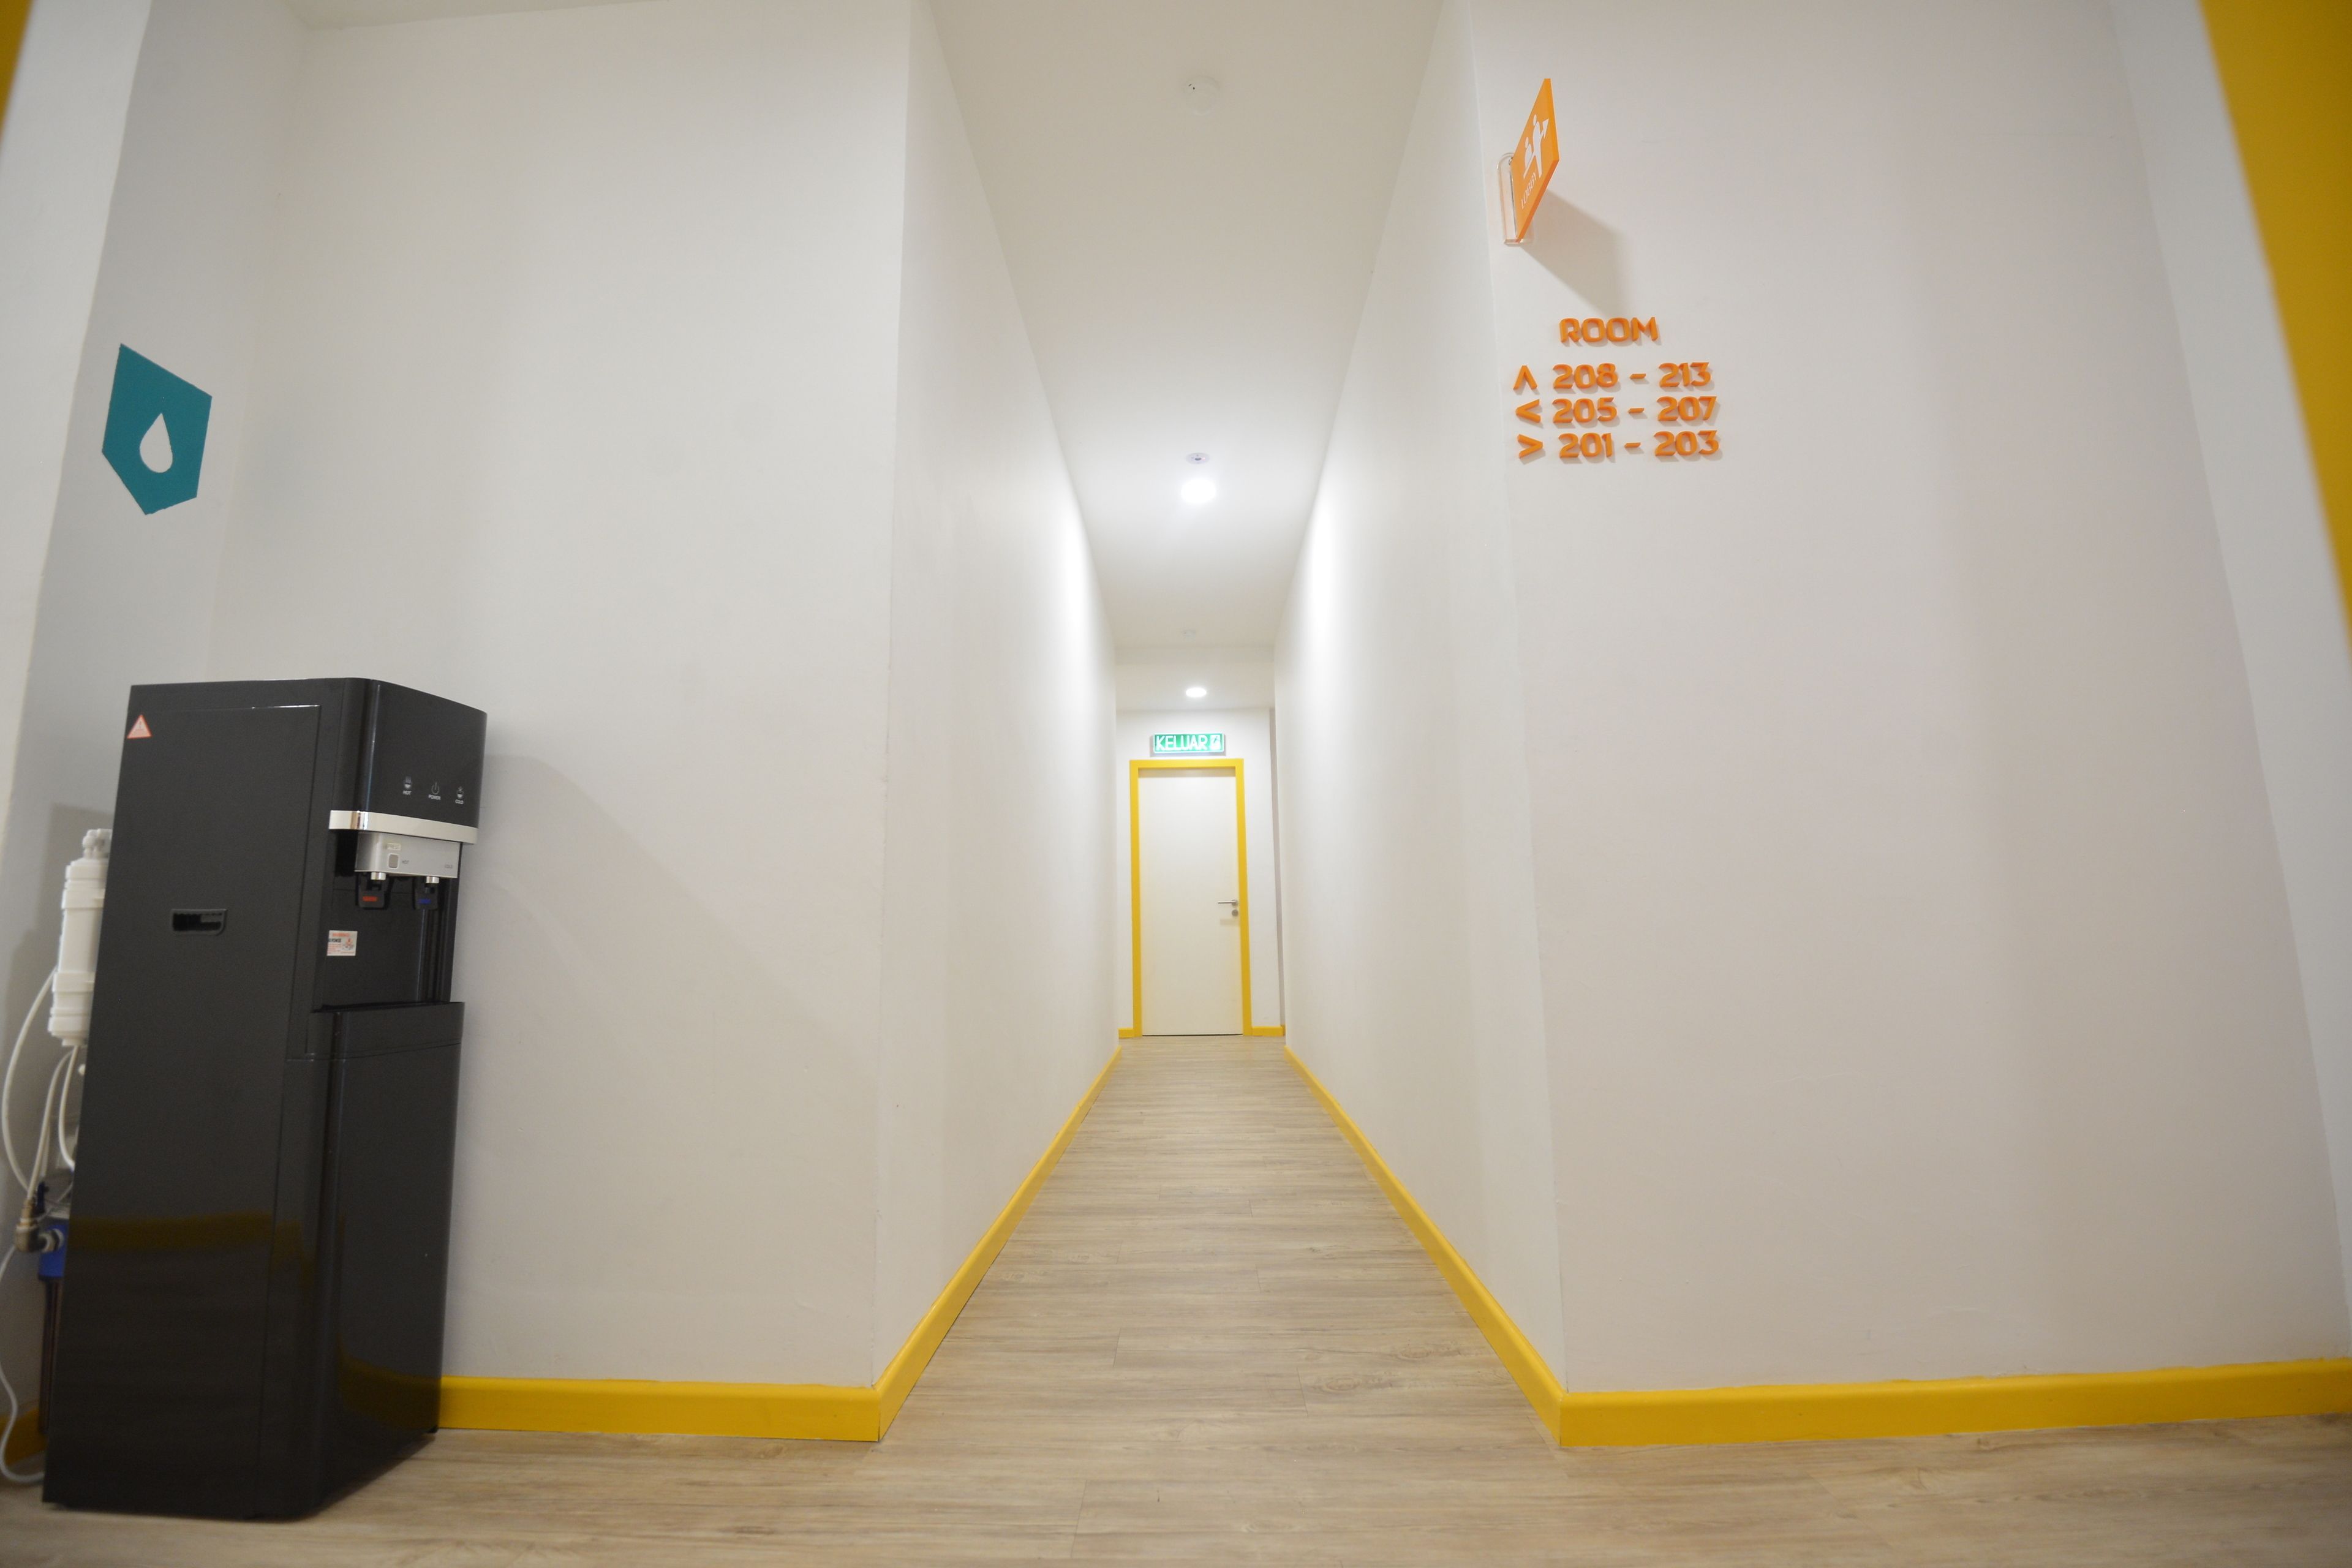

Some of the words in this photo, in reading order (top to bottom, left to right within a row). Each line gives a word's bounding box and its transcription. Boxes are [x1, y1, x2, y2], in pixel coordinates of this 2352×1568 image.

[1521, 172, 1536, 209] LOBBY
[1559, 317, 1659, 342] ROOM
[1552, 363, 1618, 389] 208
[1658, 362, 1712, 387] 213
[1552, 397, 1618, 423] 205
[1656, 396, 1717, 421] 207
[1558, 432, 1613, 458] 201
[1654, 430, 1719, 456] 203
[1155, 734, 1208, 751] KELUAR
